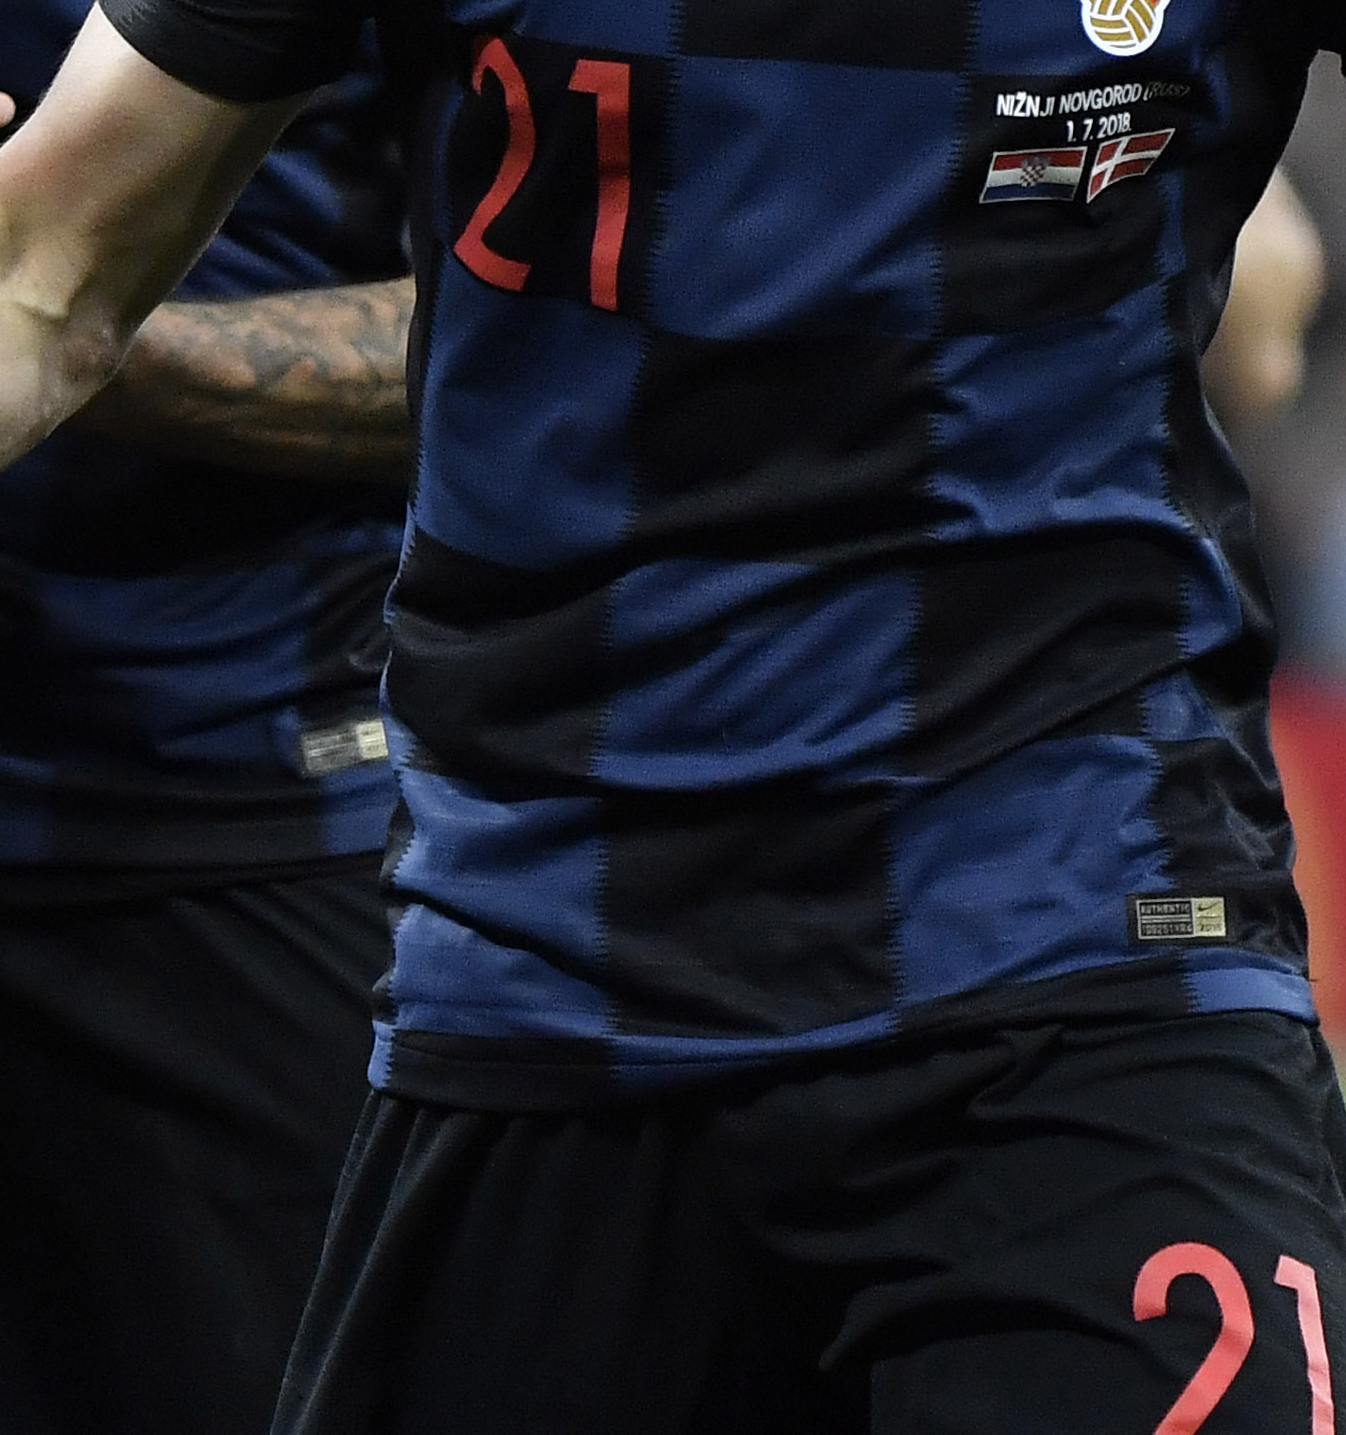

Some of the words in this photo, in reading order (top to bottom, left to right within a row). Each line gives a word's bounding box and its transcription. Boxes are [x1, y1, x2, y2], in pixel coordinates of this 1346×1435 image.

[453, 36, 632, 312] 21
[996, 91, 1055, 117] NIŽNJI
[1059, 83, 1142, 115] NOVGOROD
[1133, 1241, 1336, 1435] 21
